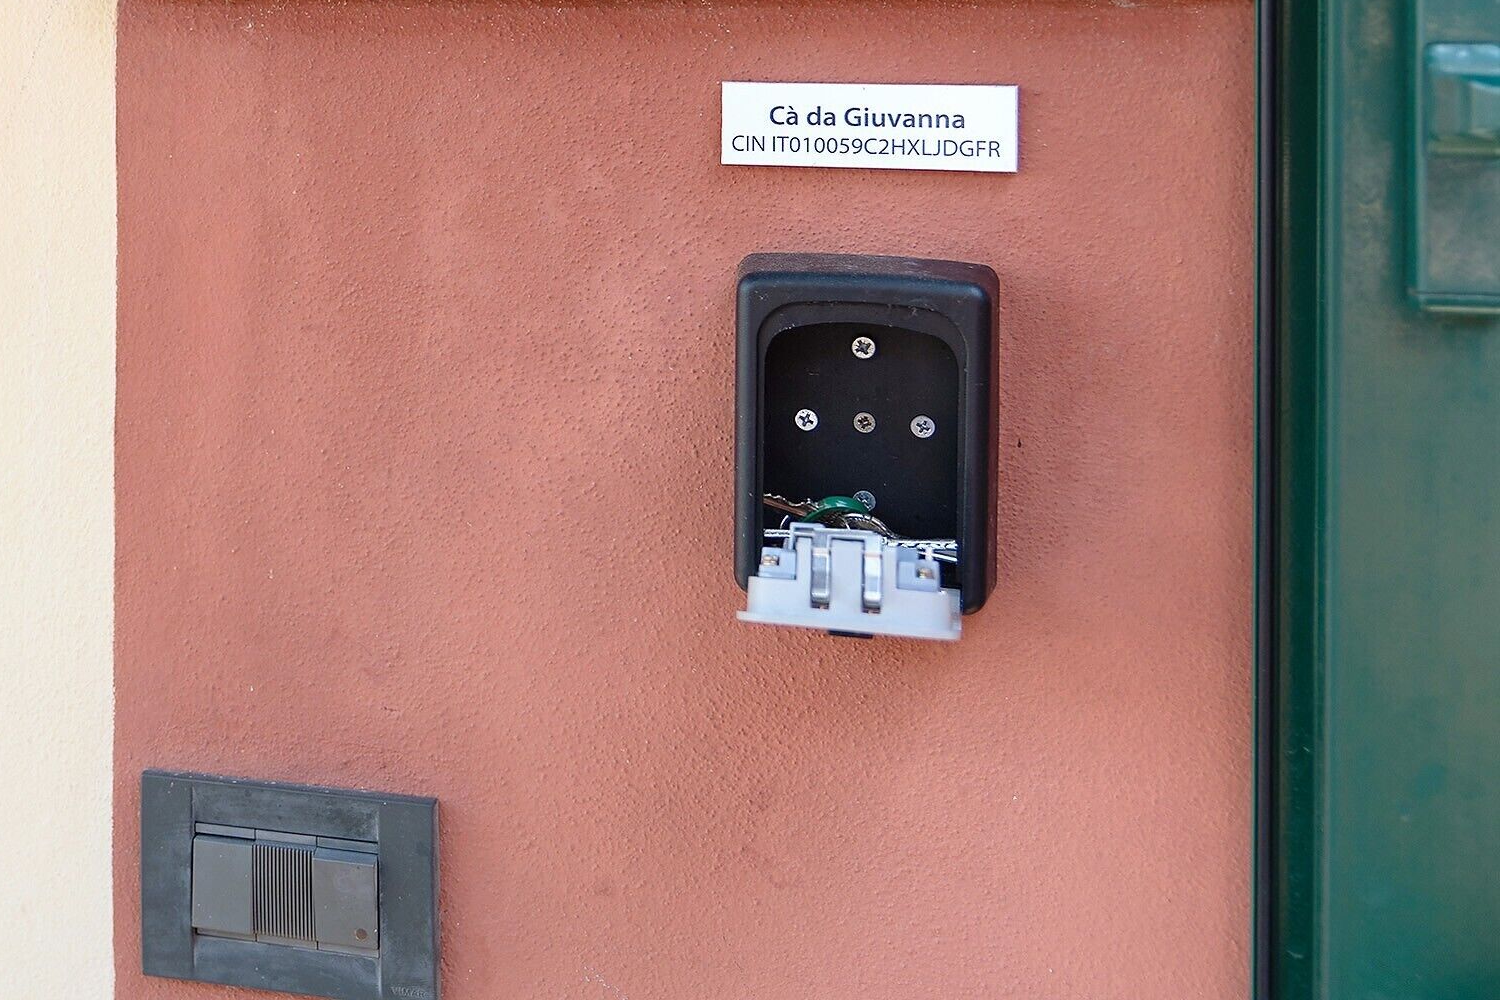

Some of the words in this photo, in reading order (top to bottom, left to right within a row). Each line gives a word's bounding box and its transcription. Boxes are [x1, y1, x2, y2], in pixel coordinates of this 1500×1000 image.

[768, 105, 799, 127] Cà
[806, 105, 837, 128] da
[844, 106, 966, 129] Giuvanna
[731, 134, 766, 153] CIN
[771, 135, 1002, 158] IT010059C2HXLJDGFR
